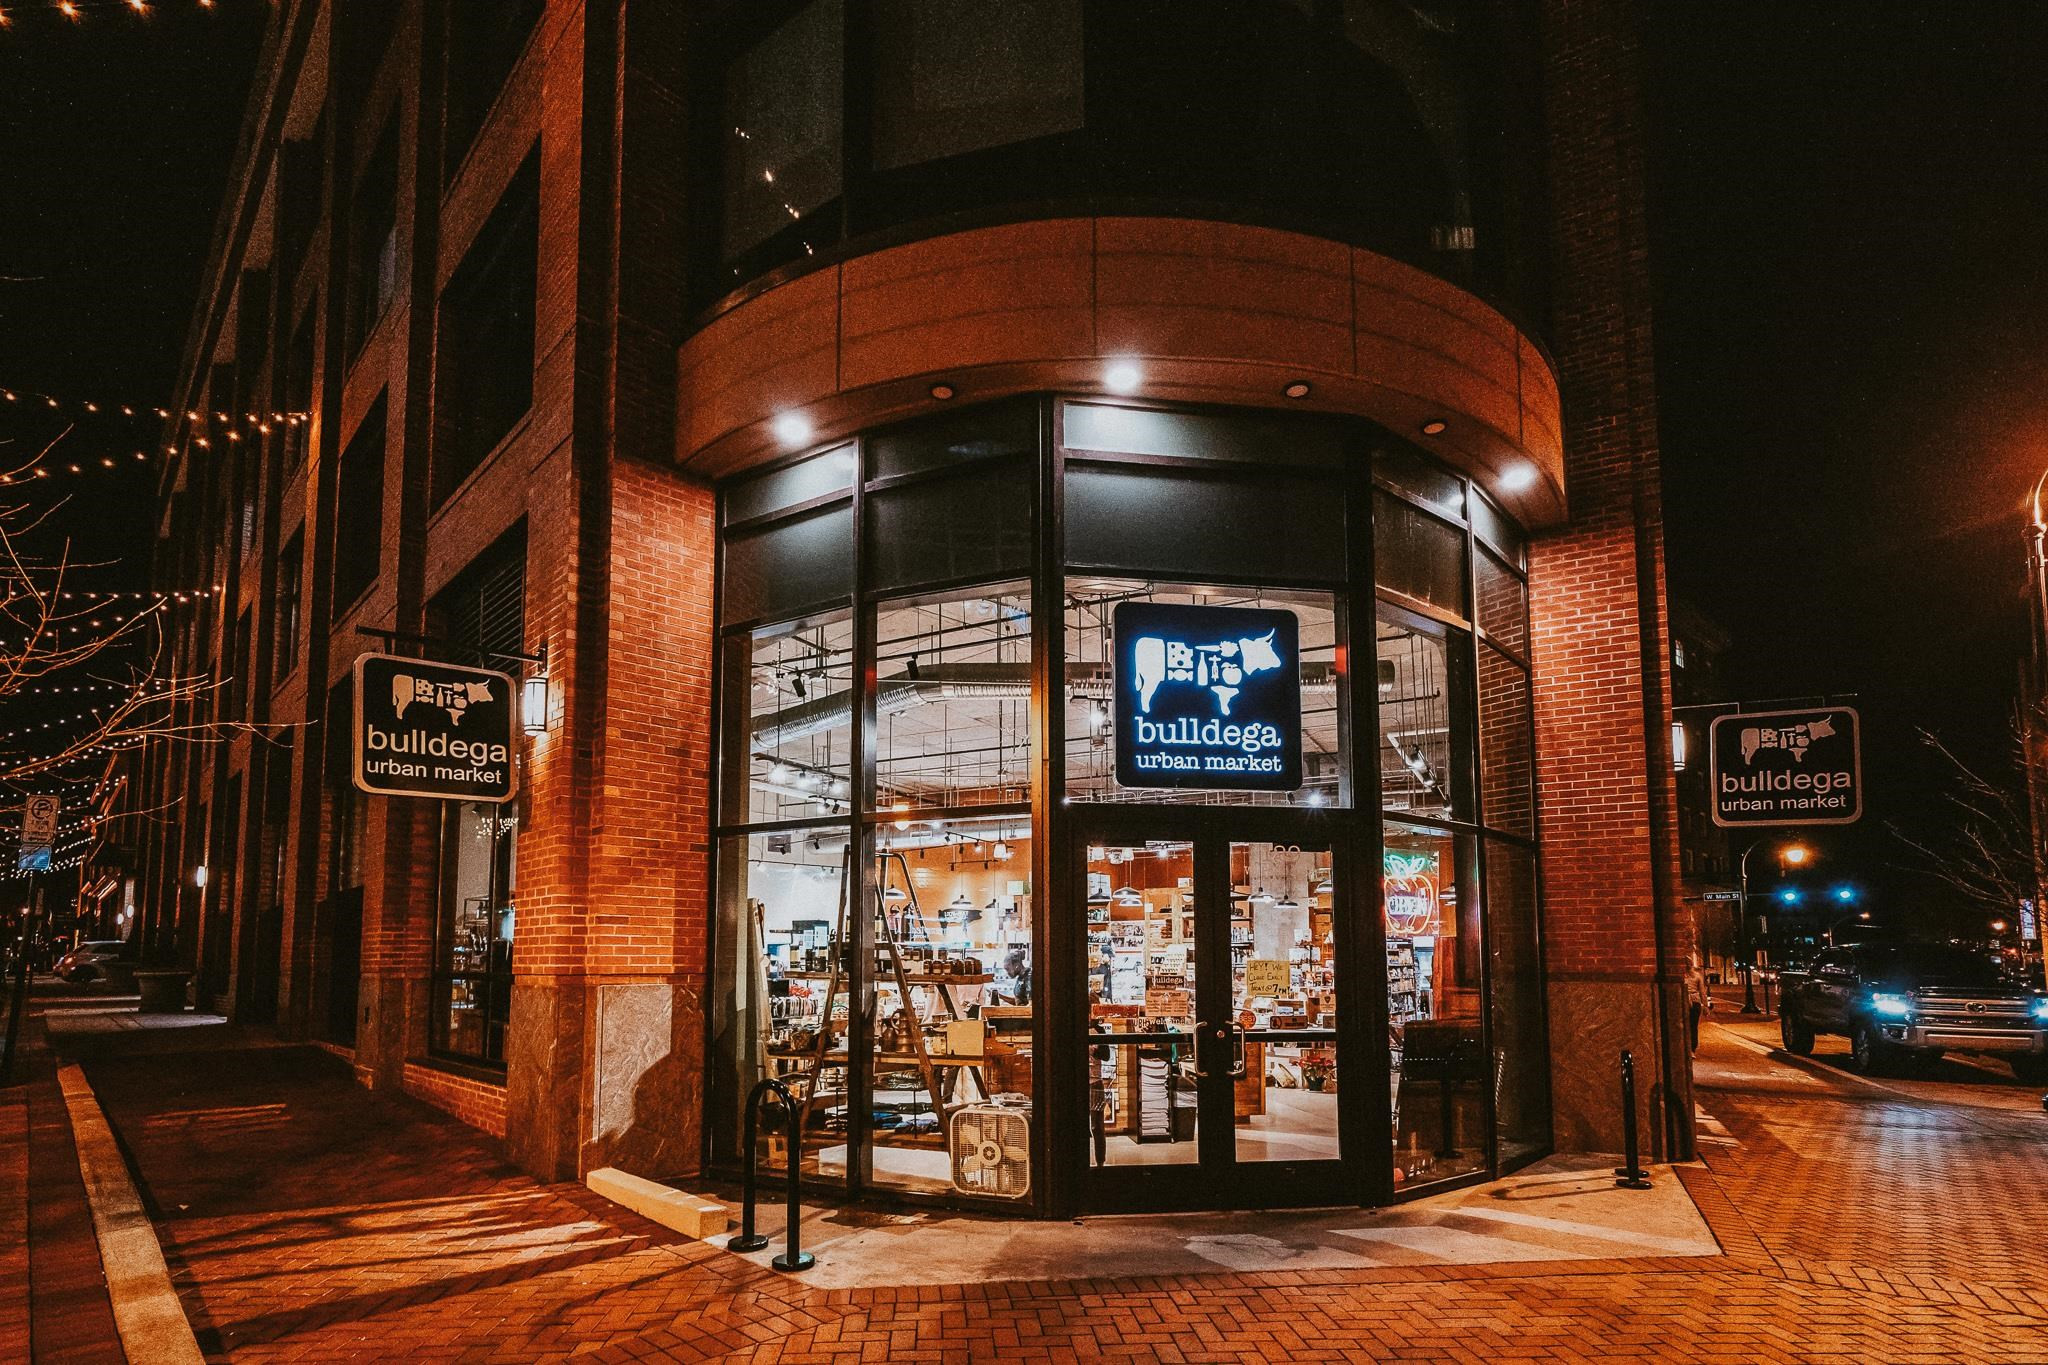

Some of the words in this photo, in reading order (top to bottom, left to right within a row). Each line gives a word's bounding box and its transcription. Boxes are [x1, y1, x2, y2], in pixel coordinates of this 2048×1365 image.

[367, 724, 508, 767] bulldega
[1134, 716, 1281, 752] bulldega
[366, 758, 427, 778] urban
[434, 766, 502, 785] market
[1135, 751, 1200, 770] urban
[1204, 754, 1282, 772] market
[1722, 769, 1852, 794] bulldega
[1721, 798, 1773, 812] urban
[1780, 794, 1847, 810] market
